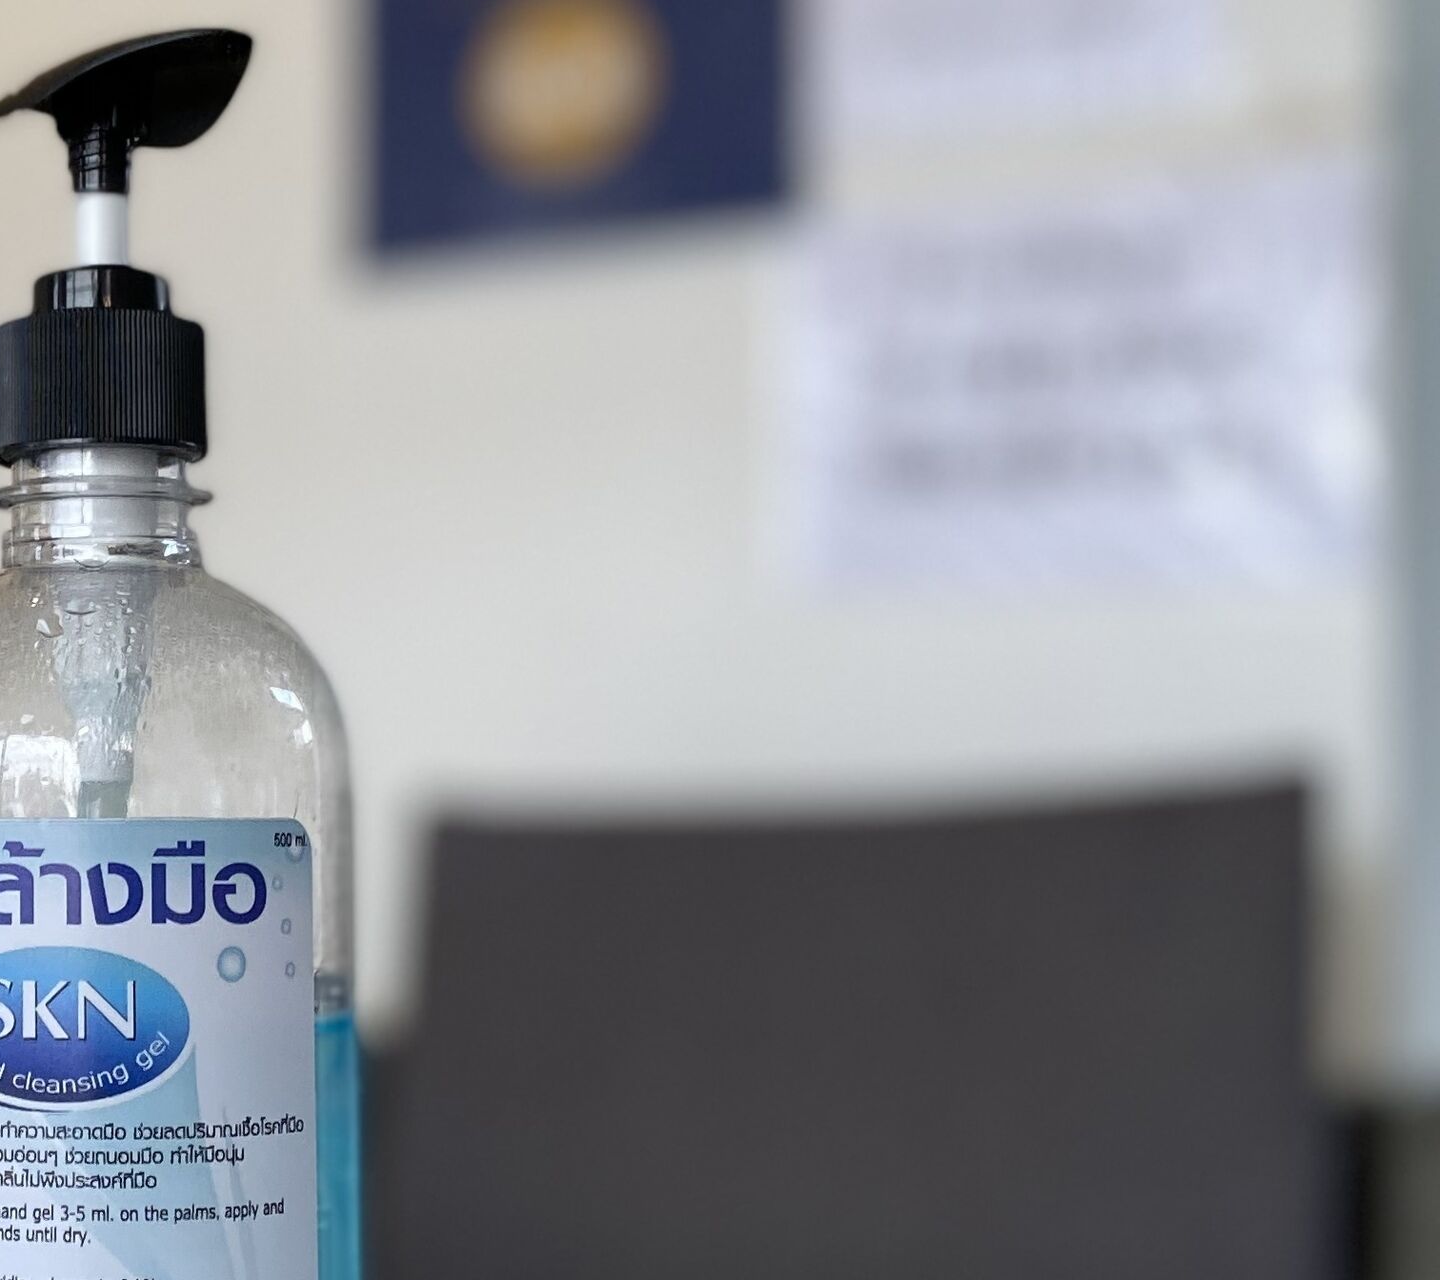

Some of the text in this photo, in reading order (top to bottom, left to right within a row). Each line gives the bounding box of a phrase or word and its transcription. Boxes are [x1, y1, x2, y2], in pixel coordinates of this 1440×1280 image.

[273, 831, 292, 847] 500
[12, 1061, 130, 1094] cleansing
[135, 1031, 172, 1072] gel
[132, 1113, 305, 1141] ช่วยลดปริมาณเชื้อโรคที่มือ
[64, 1146, 164, 1166] ช่วยถนอมมือ
[170, 1144, 245, 1167] ทำให้มือนุ่ม
[33, 1204, 55, 1224] gel
[60, 1204, 86, 1222] 3-5
[91, 1204, 114, 1222] ml.
[119, 1207, 139, 1222] on
[144, 1204, 169, 1222] the
[173, 1203, 220, 1224] palms,
[224, 1199, 259, 1222] apply
[262, 1196, 285, 1216] and
[25, 1226, 57, 1243] until
[62, 1226, 92, 1248] dry.
